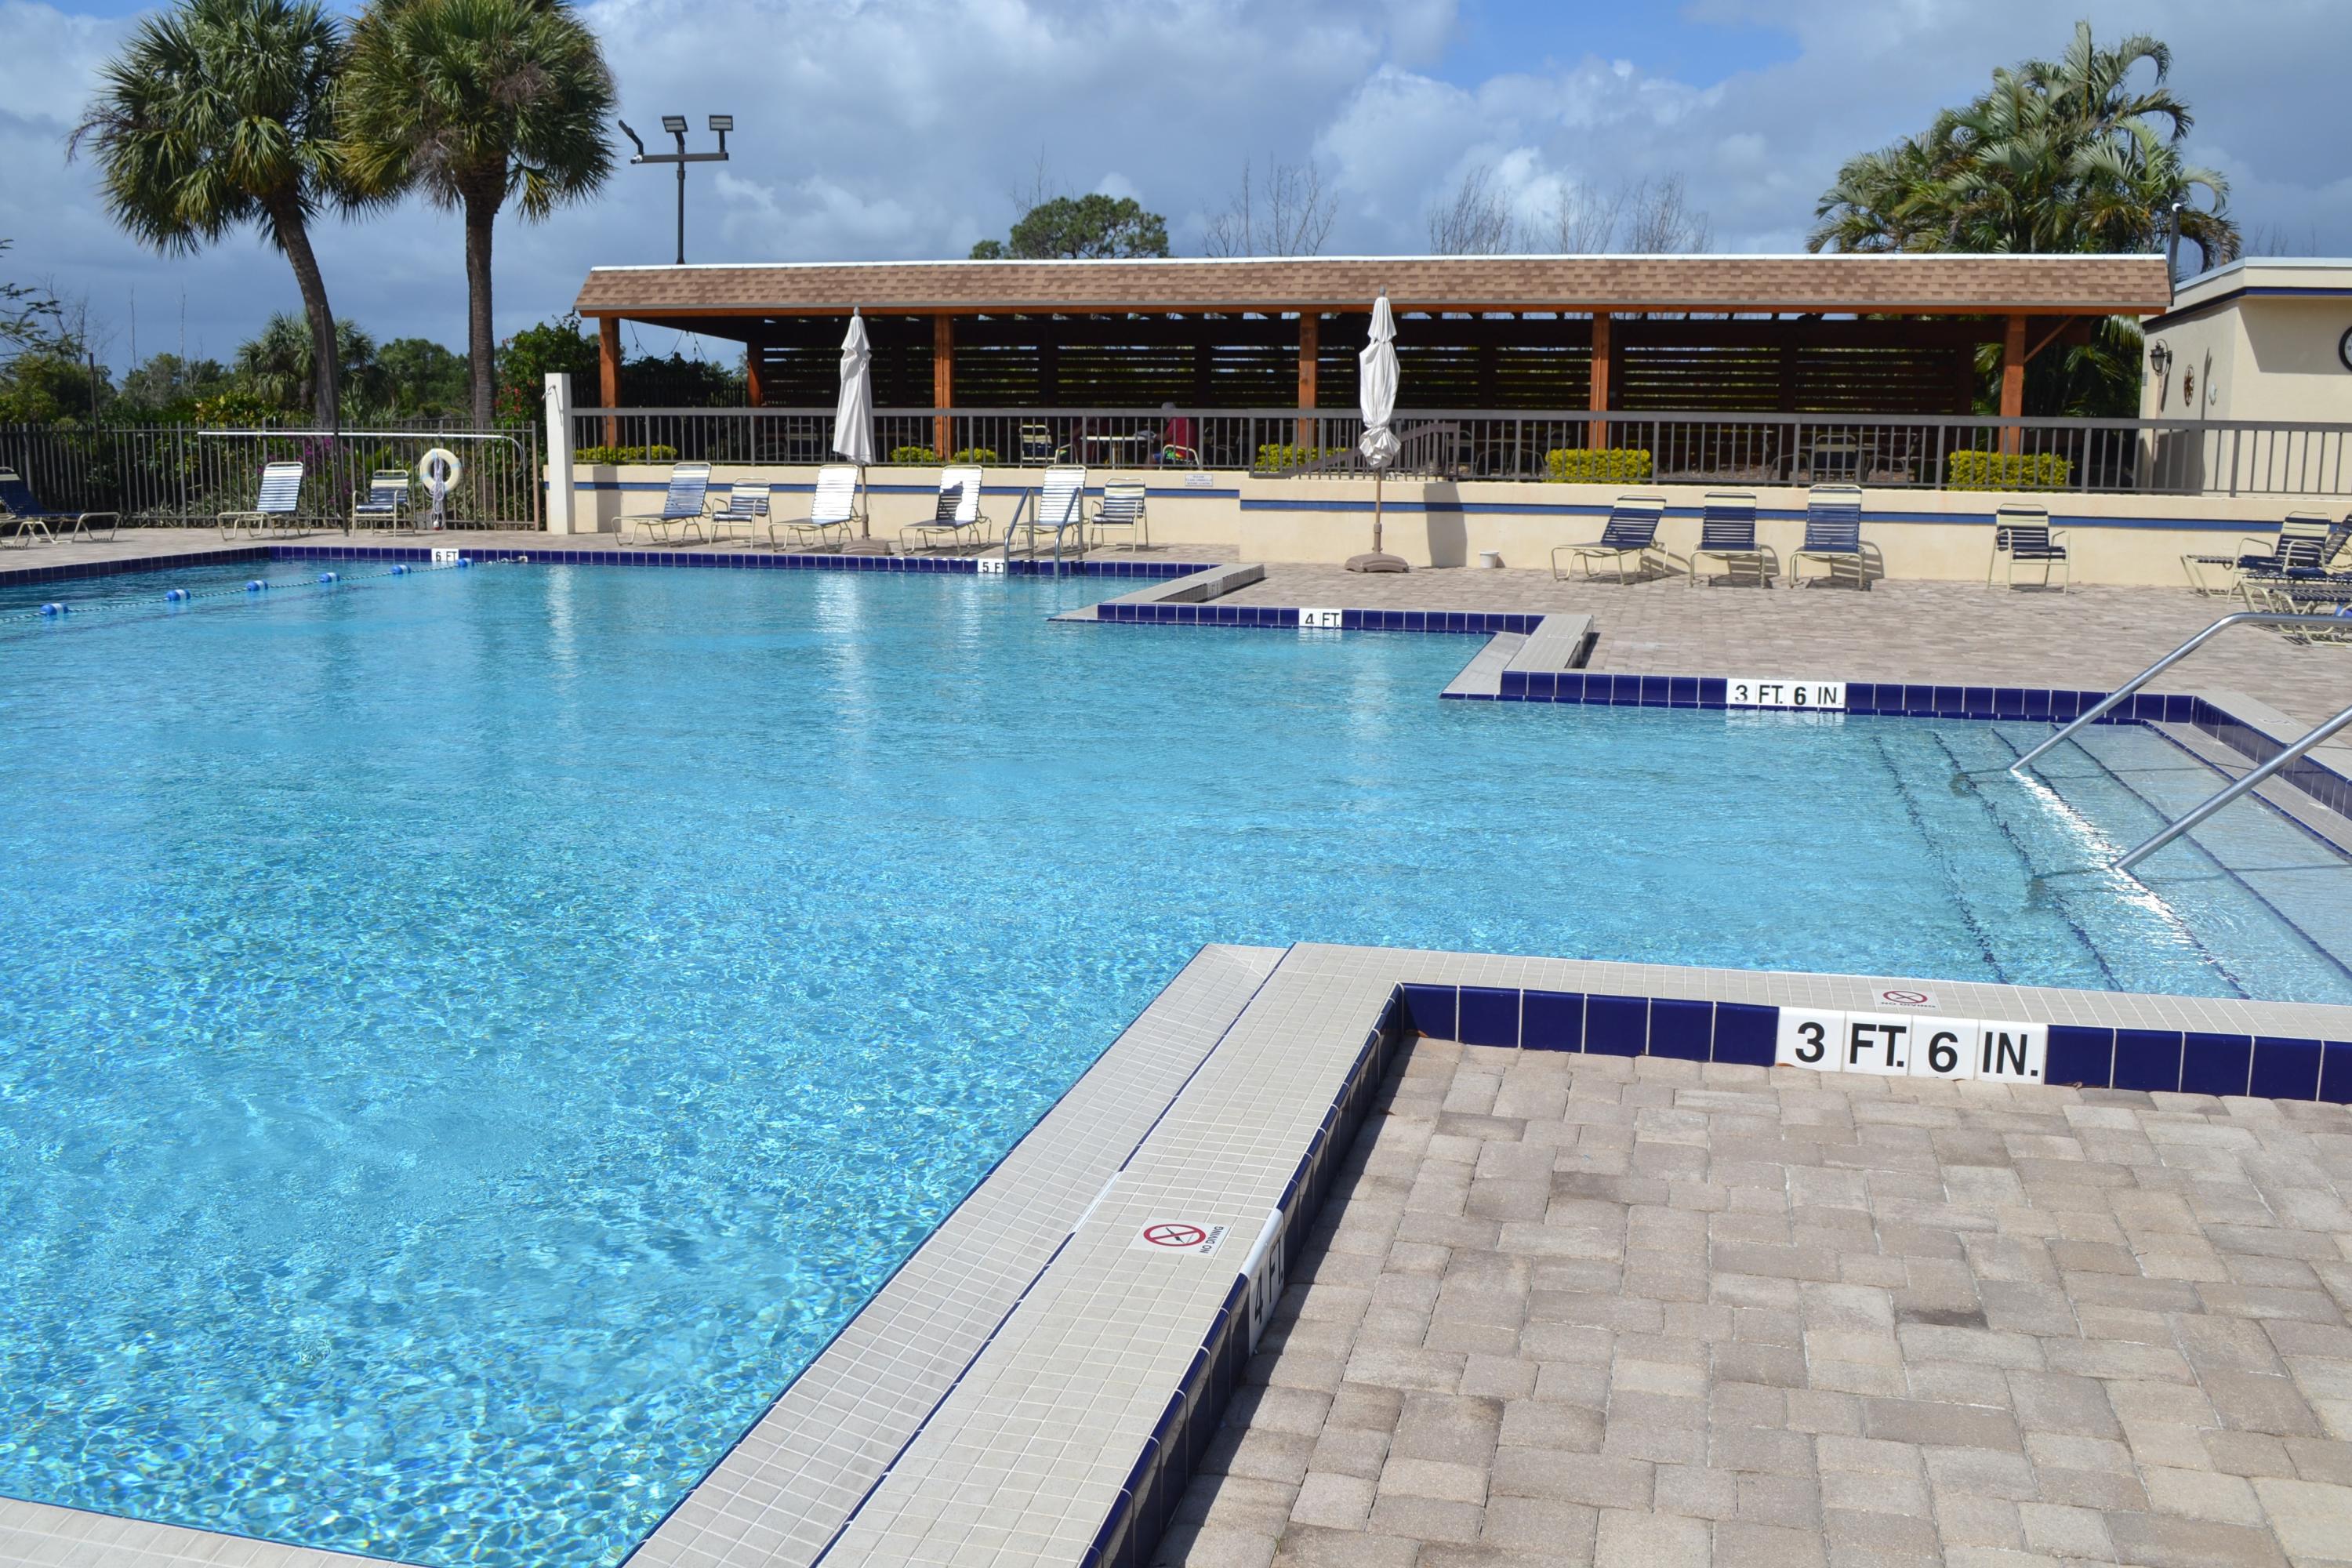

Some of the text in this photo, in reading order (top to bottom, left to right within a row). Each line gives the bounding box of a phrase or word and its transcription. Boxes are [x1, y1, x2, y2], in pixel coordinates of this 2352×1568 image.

[436, 551, 457, 563] 6 FT
[982, 562, 989, 573] 5
[1305, 612, 1340, 626] 4 FT.
[1735, 684, 1842, 706] 3 FT. 6 IN.
[1795, 1022, 2039, 1076] 3 FT. 6 IN.
[1199, 1225, 1225, 1254] NO DIVING
[1254, 1267, 1264, 1326] 4
